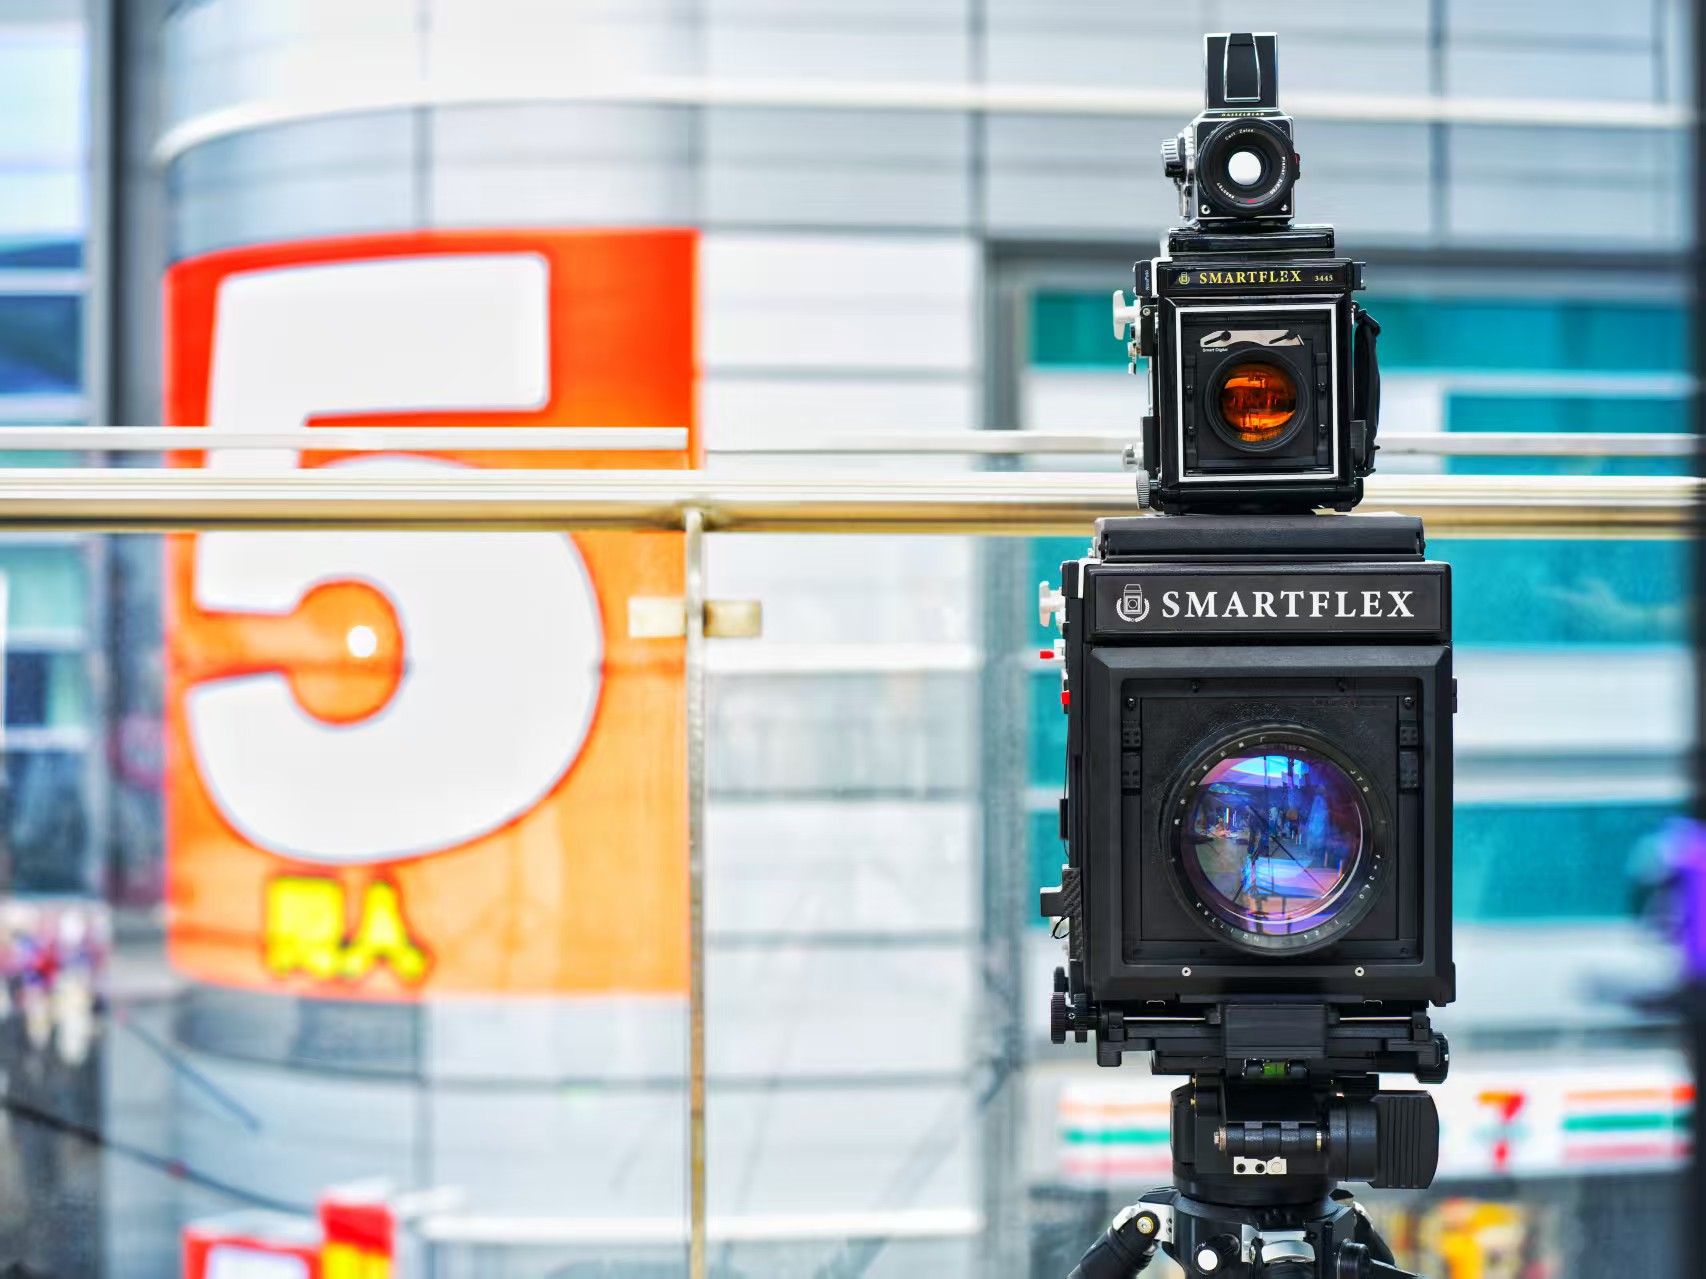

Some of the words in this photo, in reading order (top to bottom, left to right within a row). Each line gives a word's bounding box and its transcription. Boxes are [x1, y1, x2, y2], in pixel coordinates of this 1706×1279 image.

[1199, 270, 1302, 284] SMARTFLEX
[1314, 274, 1334, 282] 3445
[186, 254, 605, 863] 5
[1161, 590, 1415, 618] SMARTFLEX
